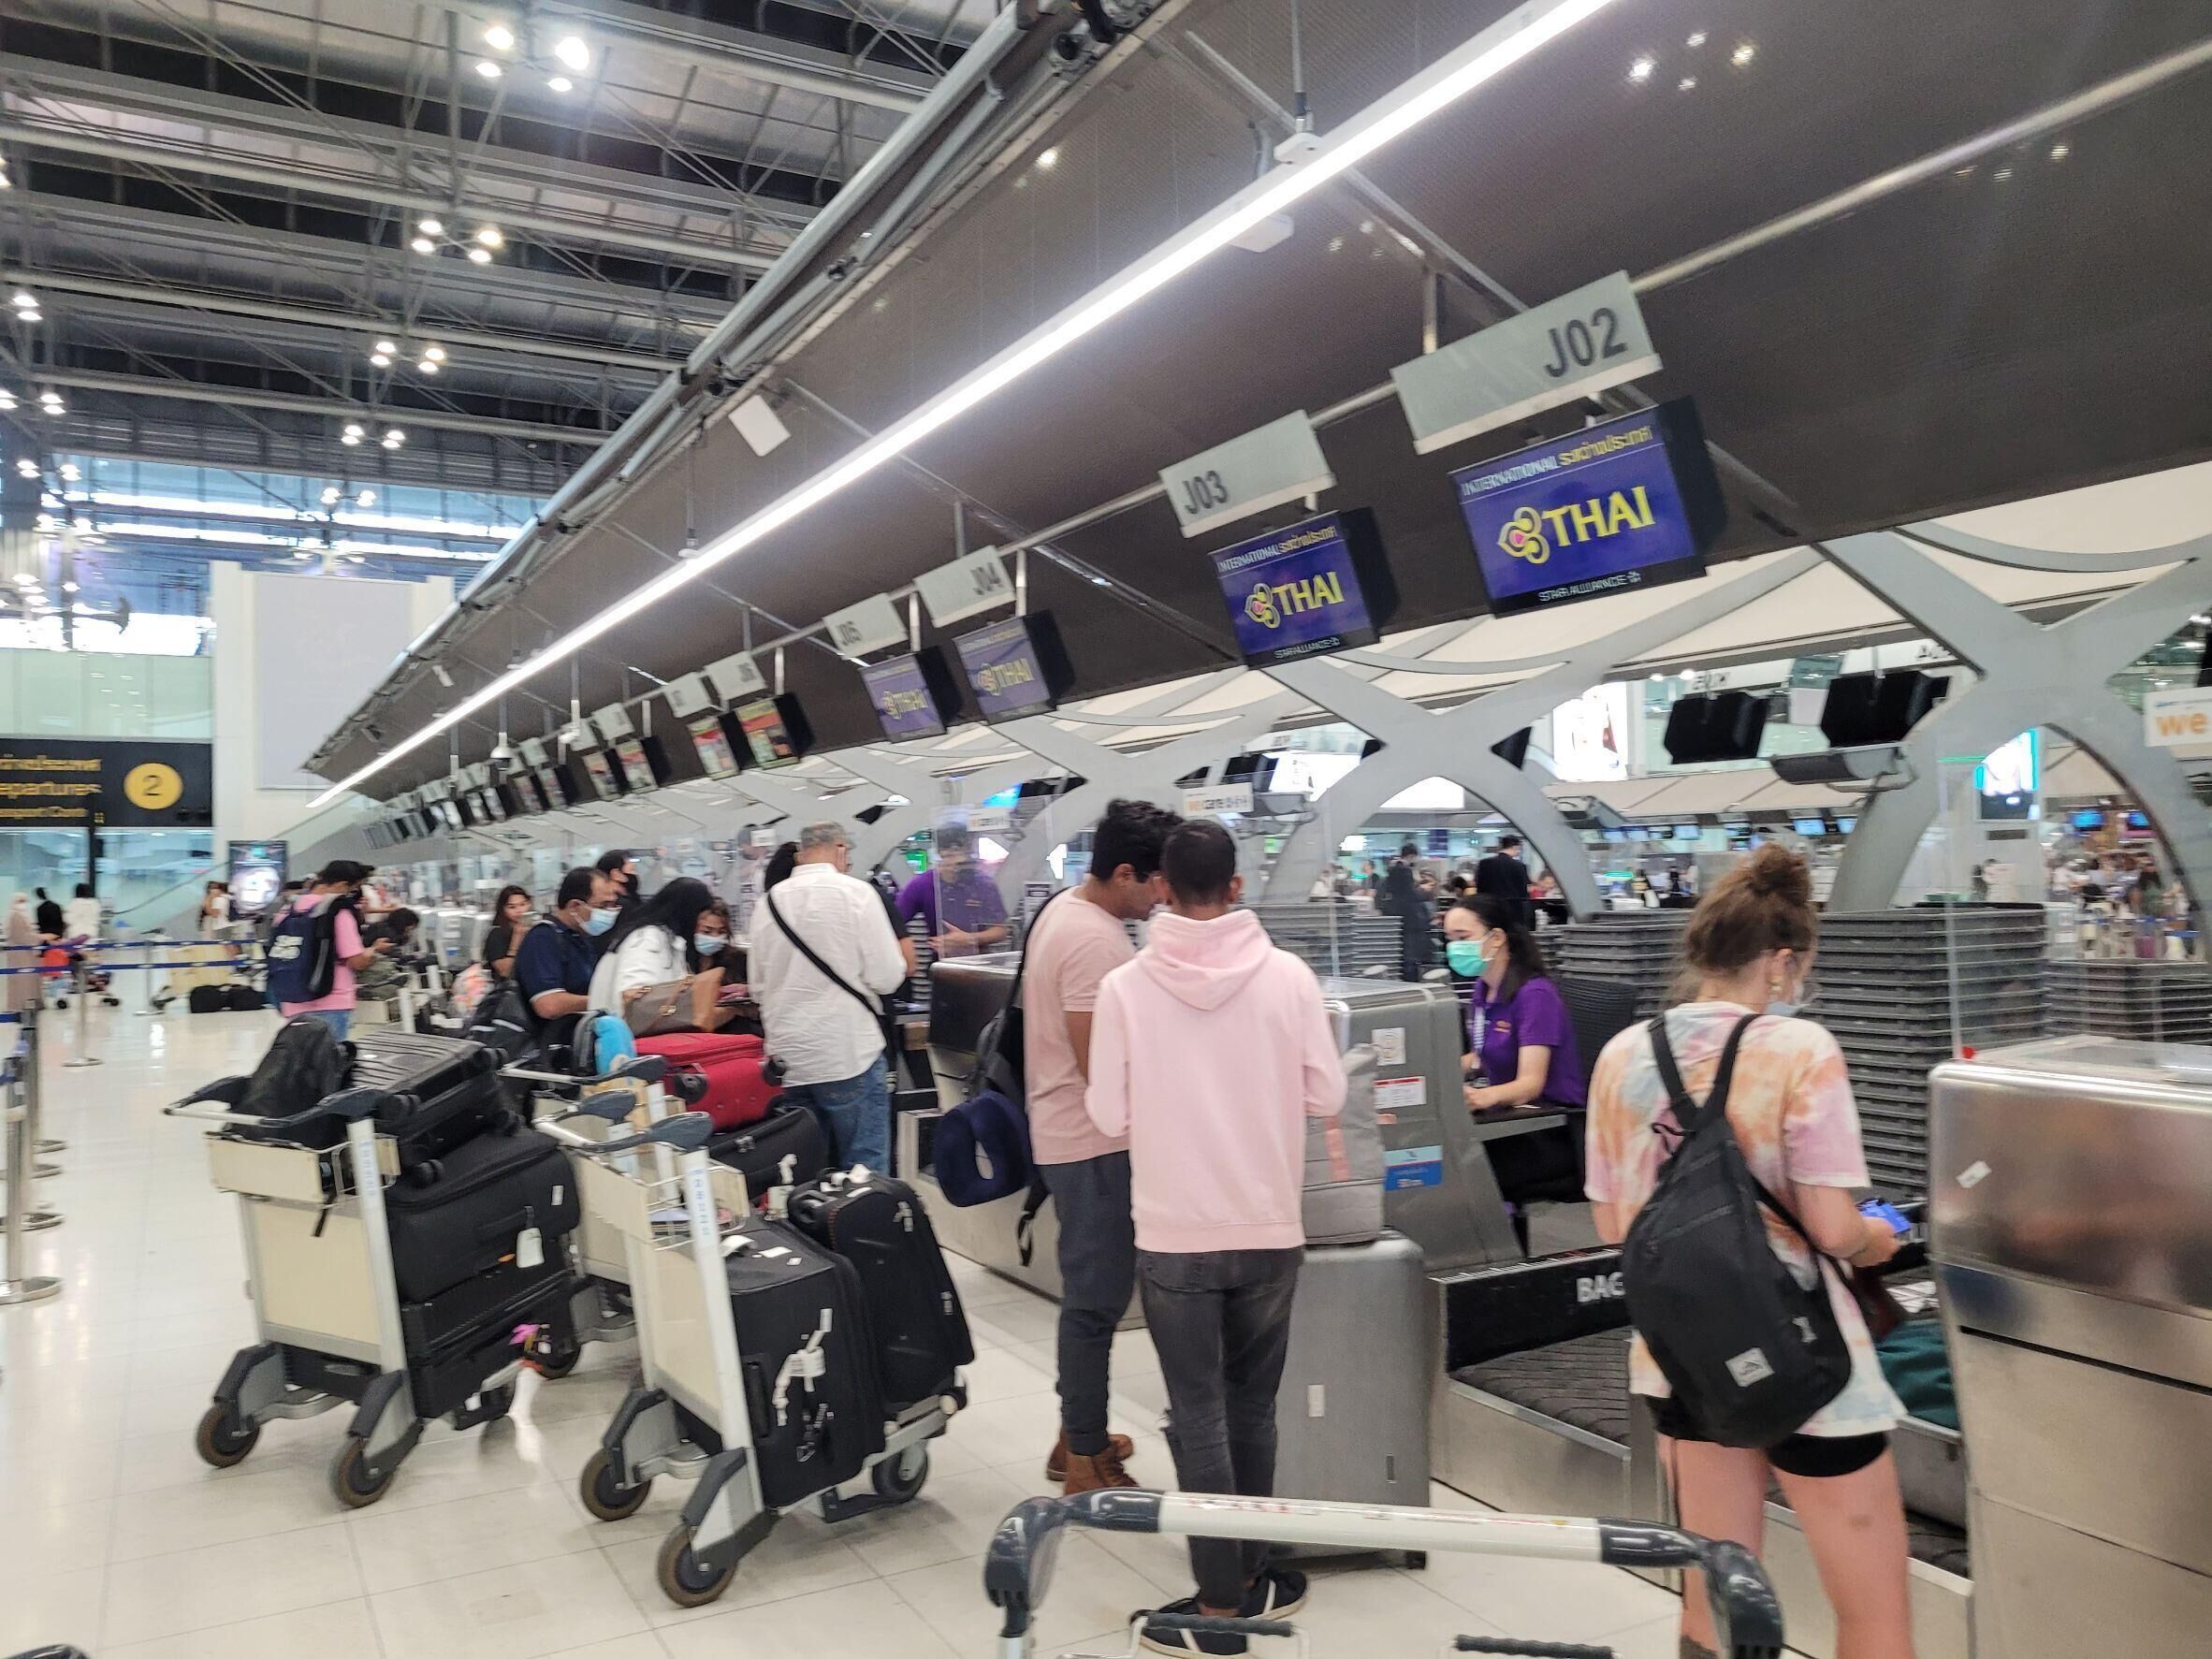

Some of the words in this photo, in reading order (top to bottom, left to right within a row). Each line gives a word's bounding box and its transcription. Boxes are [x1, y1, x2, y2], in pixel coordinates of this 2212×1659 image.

[1544, 307, 1628, 378] J02
[1182, 470, 1228, 515] J03
[1461, 456, 1561, 496] INTERNATIONAL
[1542, 486, 1655, 547] THAI
[1271, 571, 1346, 617] THAI
[1538, 588, 1572, 602] STAR
[1570, 575, 1629, 595] ALLIANCE
[2155, 712, 2207, 736] we
[142, 774, 163, 796] 2
